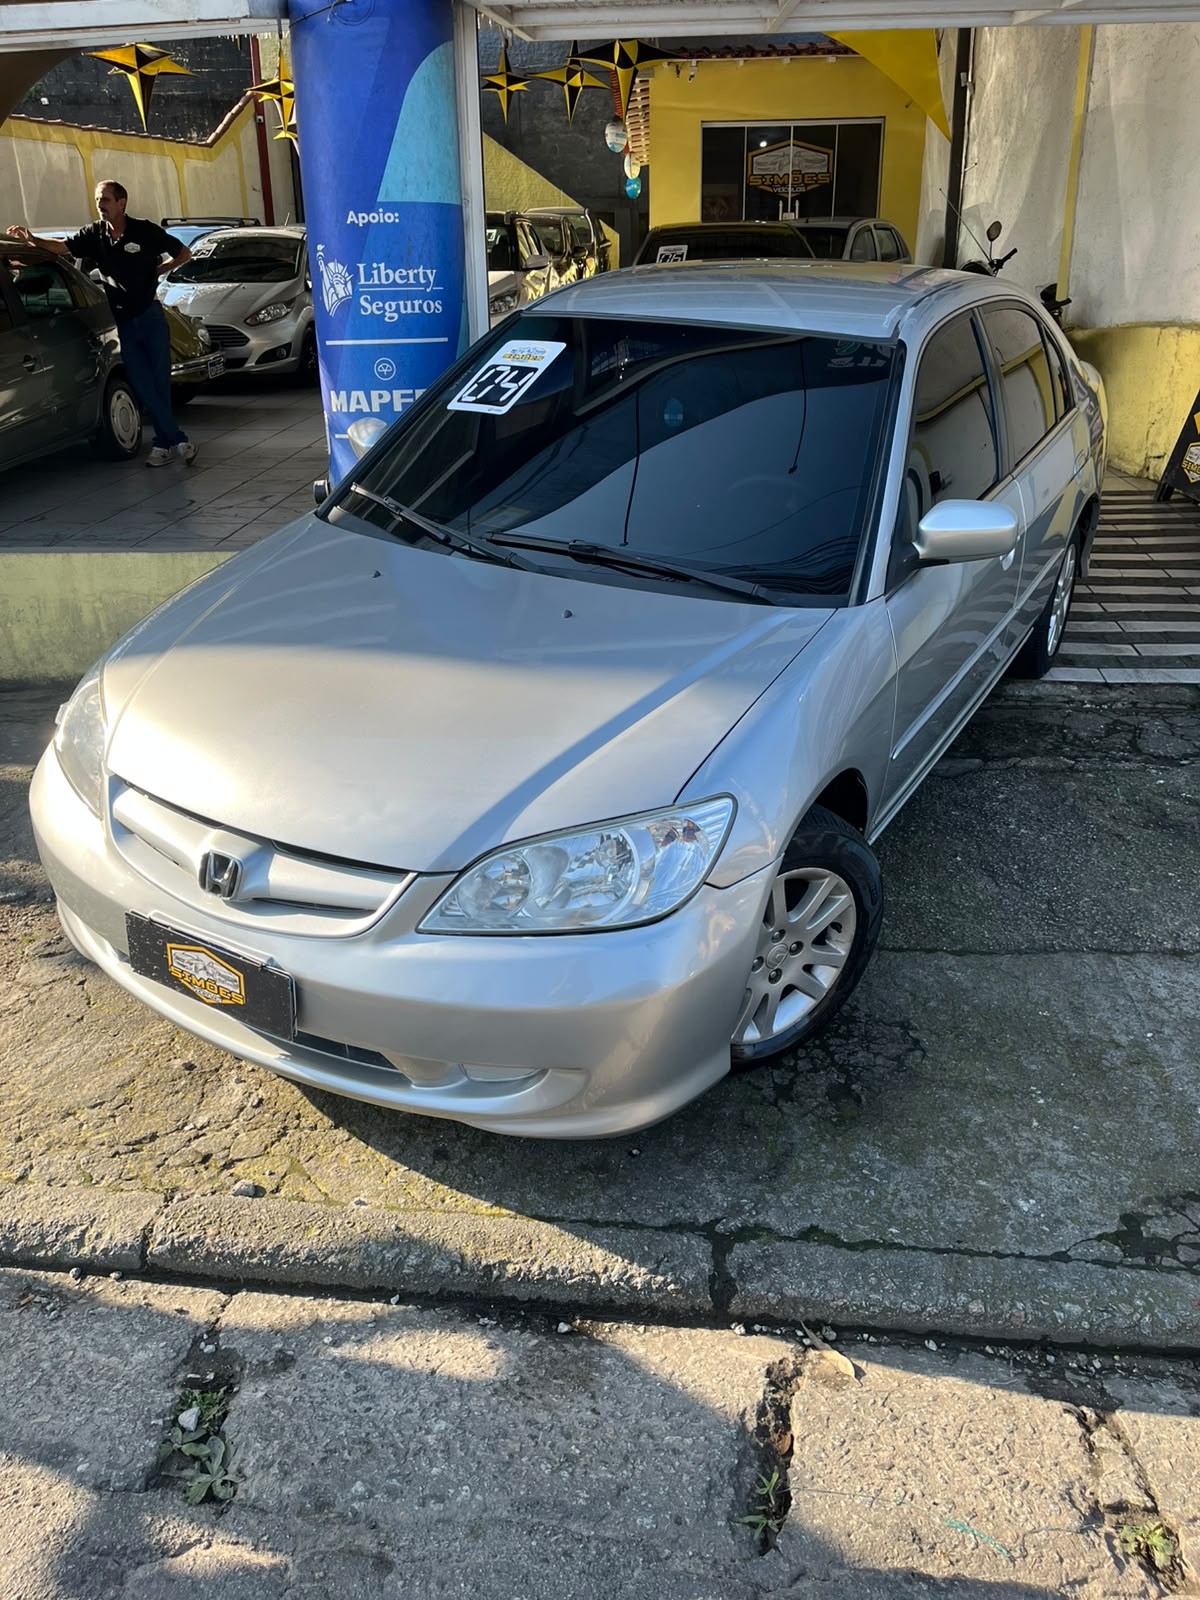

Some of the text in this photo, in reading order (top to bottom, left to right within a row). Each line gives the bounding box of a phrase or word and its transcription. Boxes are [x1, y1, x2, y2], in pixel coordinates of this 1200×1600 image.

[346, 208, 400, 227] Apoio:
[356, 262, 437, 292] Liberty
[360, 295, 443, 322] Seguros
[461, 365, 534, 402] 04
[170, 965, 245, 1006] SIMÕES
